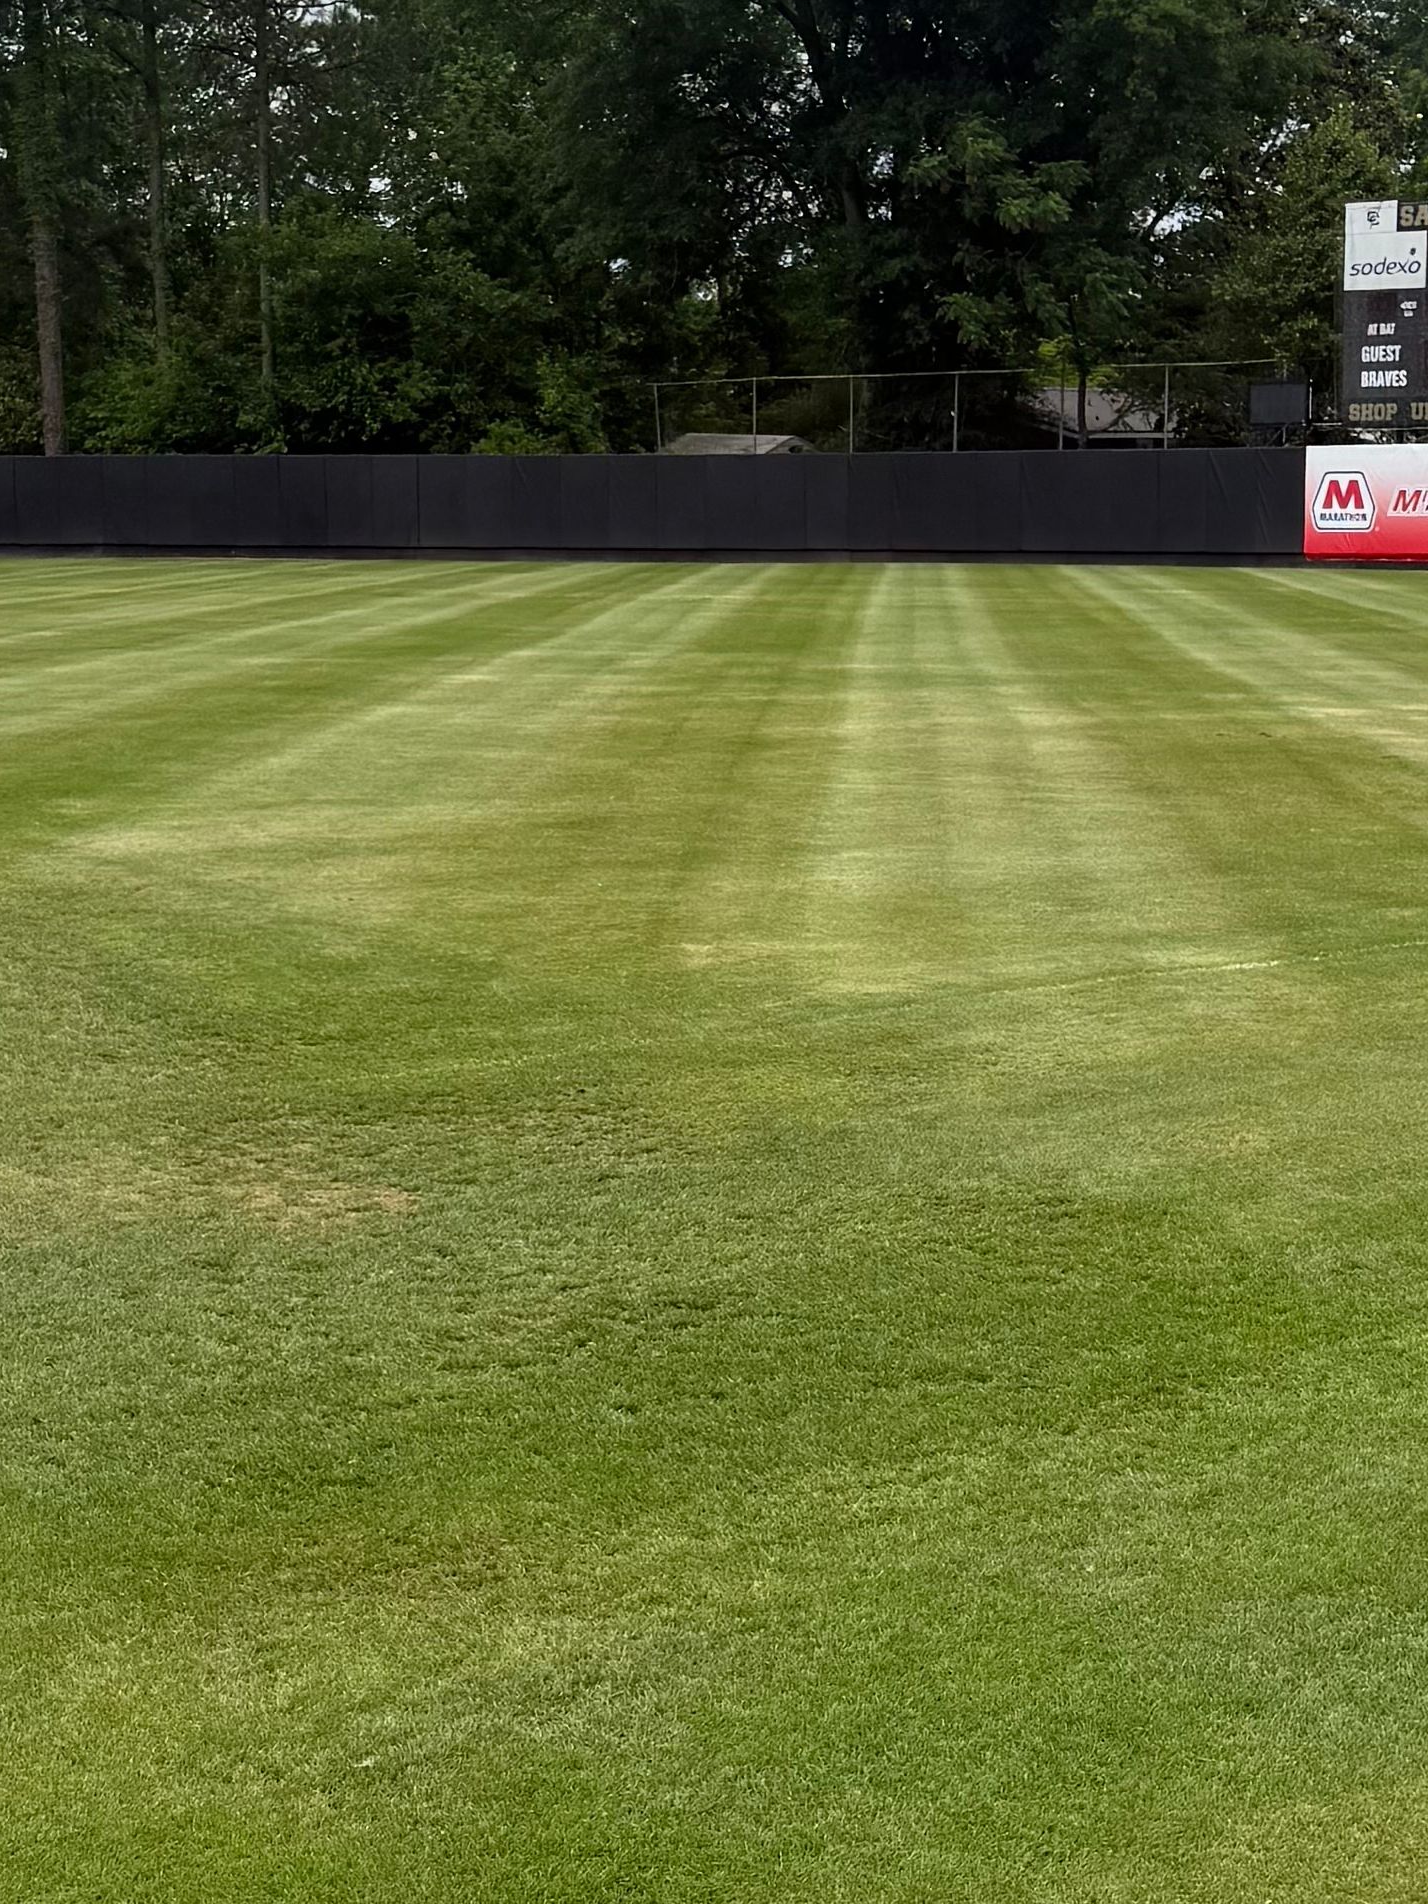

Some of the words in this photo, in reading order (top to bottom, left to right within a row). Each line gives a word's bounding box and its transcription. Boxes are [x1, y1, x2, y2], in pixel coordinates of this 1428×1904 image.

[1349, 256, 1422, 277] sodexo
[1361, 345, 1401, 362] GUEST
[1361, 370, 1407, 387] BRAVES
[1348, 402, 1398, 421] SHOP
